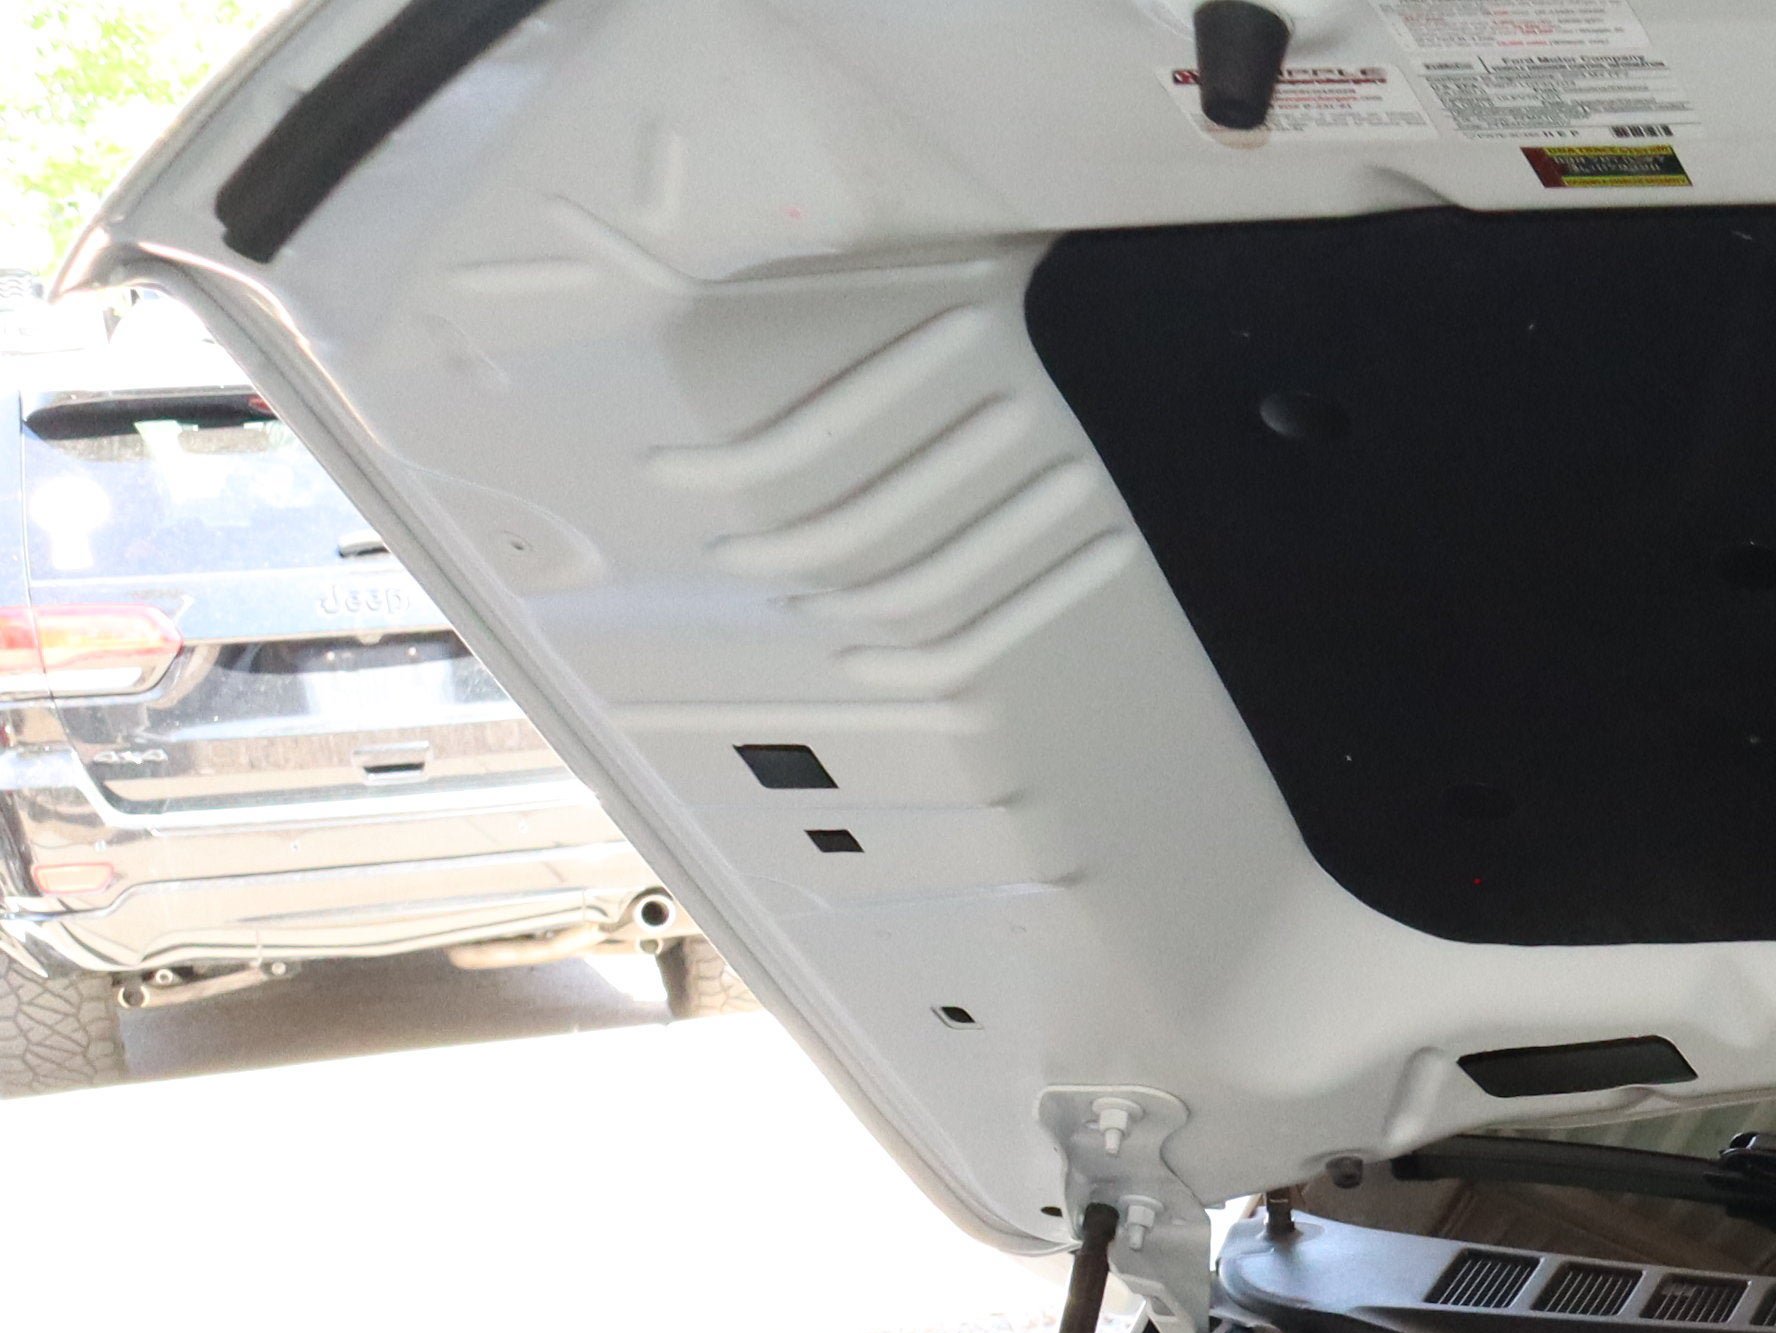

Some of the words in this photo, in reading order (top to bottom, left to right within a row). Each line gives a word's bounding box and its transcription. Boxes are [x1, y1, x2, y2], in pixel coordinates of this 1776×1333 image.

[1502, 56, 1534, 65] Ford
[1537, 55, 1576, 64] Motor
[319, 584, 410, 615] Jeep
